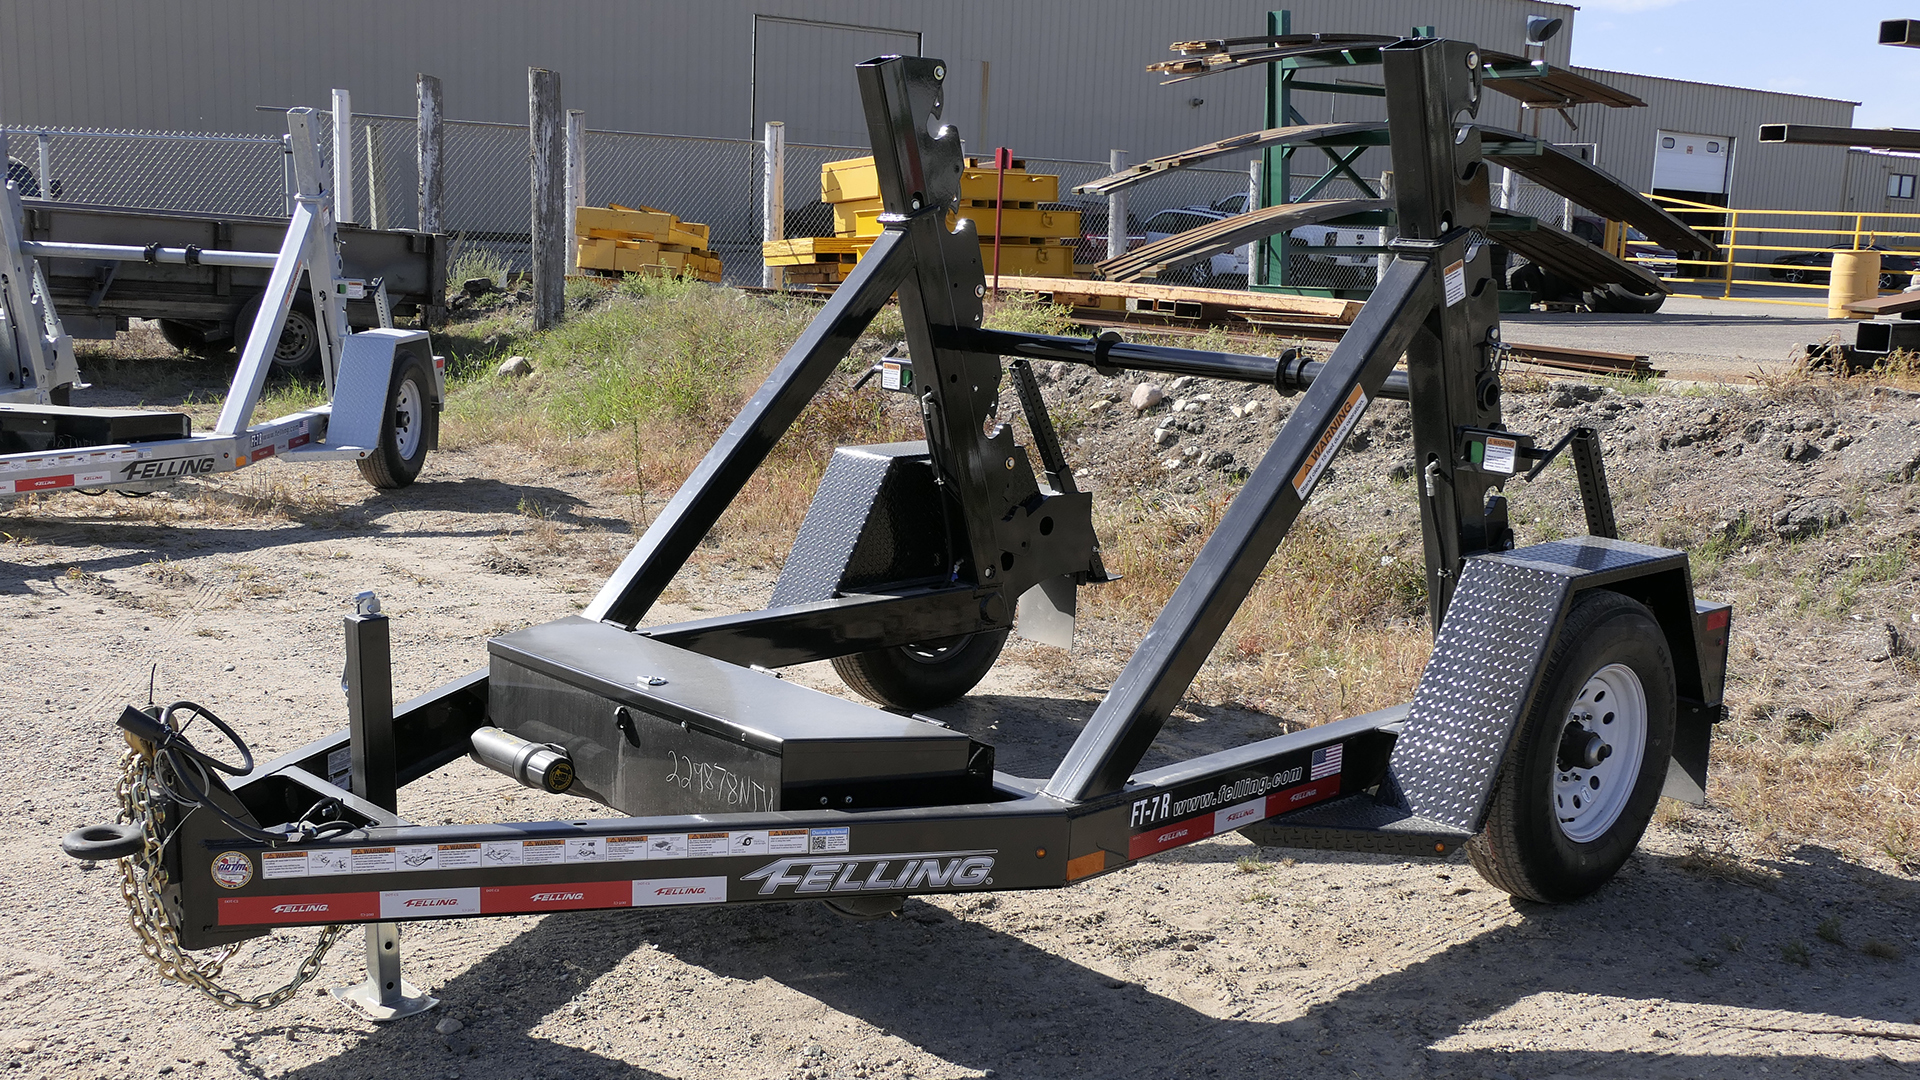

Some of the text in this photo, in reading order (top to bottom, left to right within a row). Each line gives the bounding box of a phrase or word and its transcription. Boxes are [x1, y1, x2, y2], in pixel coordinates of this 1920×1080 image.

[1311, 401, 1353, 460] WARNING
[119, 453, 216, 480] FELLING
[1300, 475, 1313, 494] Stand
[1173, 766, 1303, 817] www.felling.com
[1290, 788, 1317, 802] FELLING
[1226, 808, 1255, 822] FELLING
[1157, 829, 1188, 843] FELLING
[740, 849, 998, 894] FELLING
[530, 892, 584, 902] FELLING
[654, 886, 706, 896] FELLING
[271, 904, 329, 913] FELLING
[403, 898, 459, 908] FELLING
